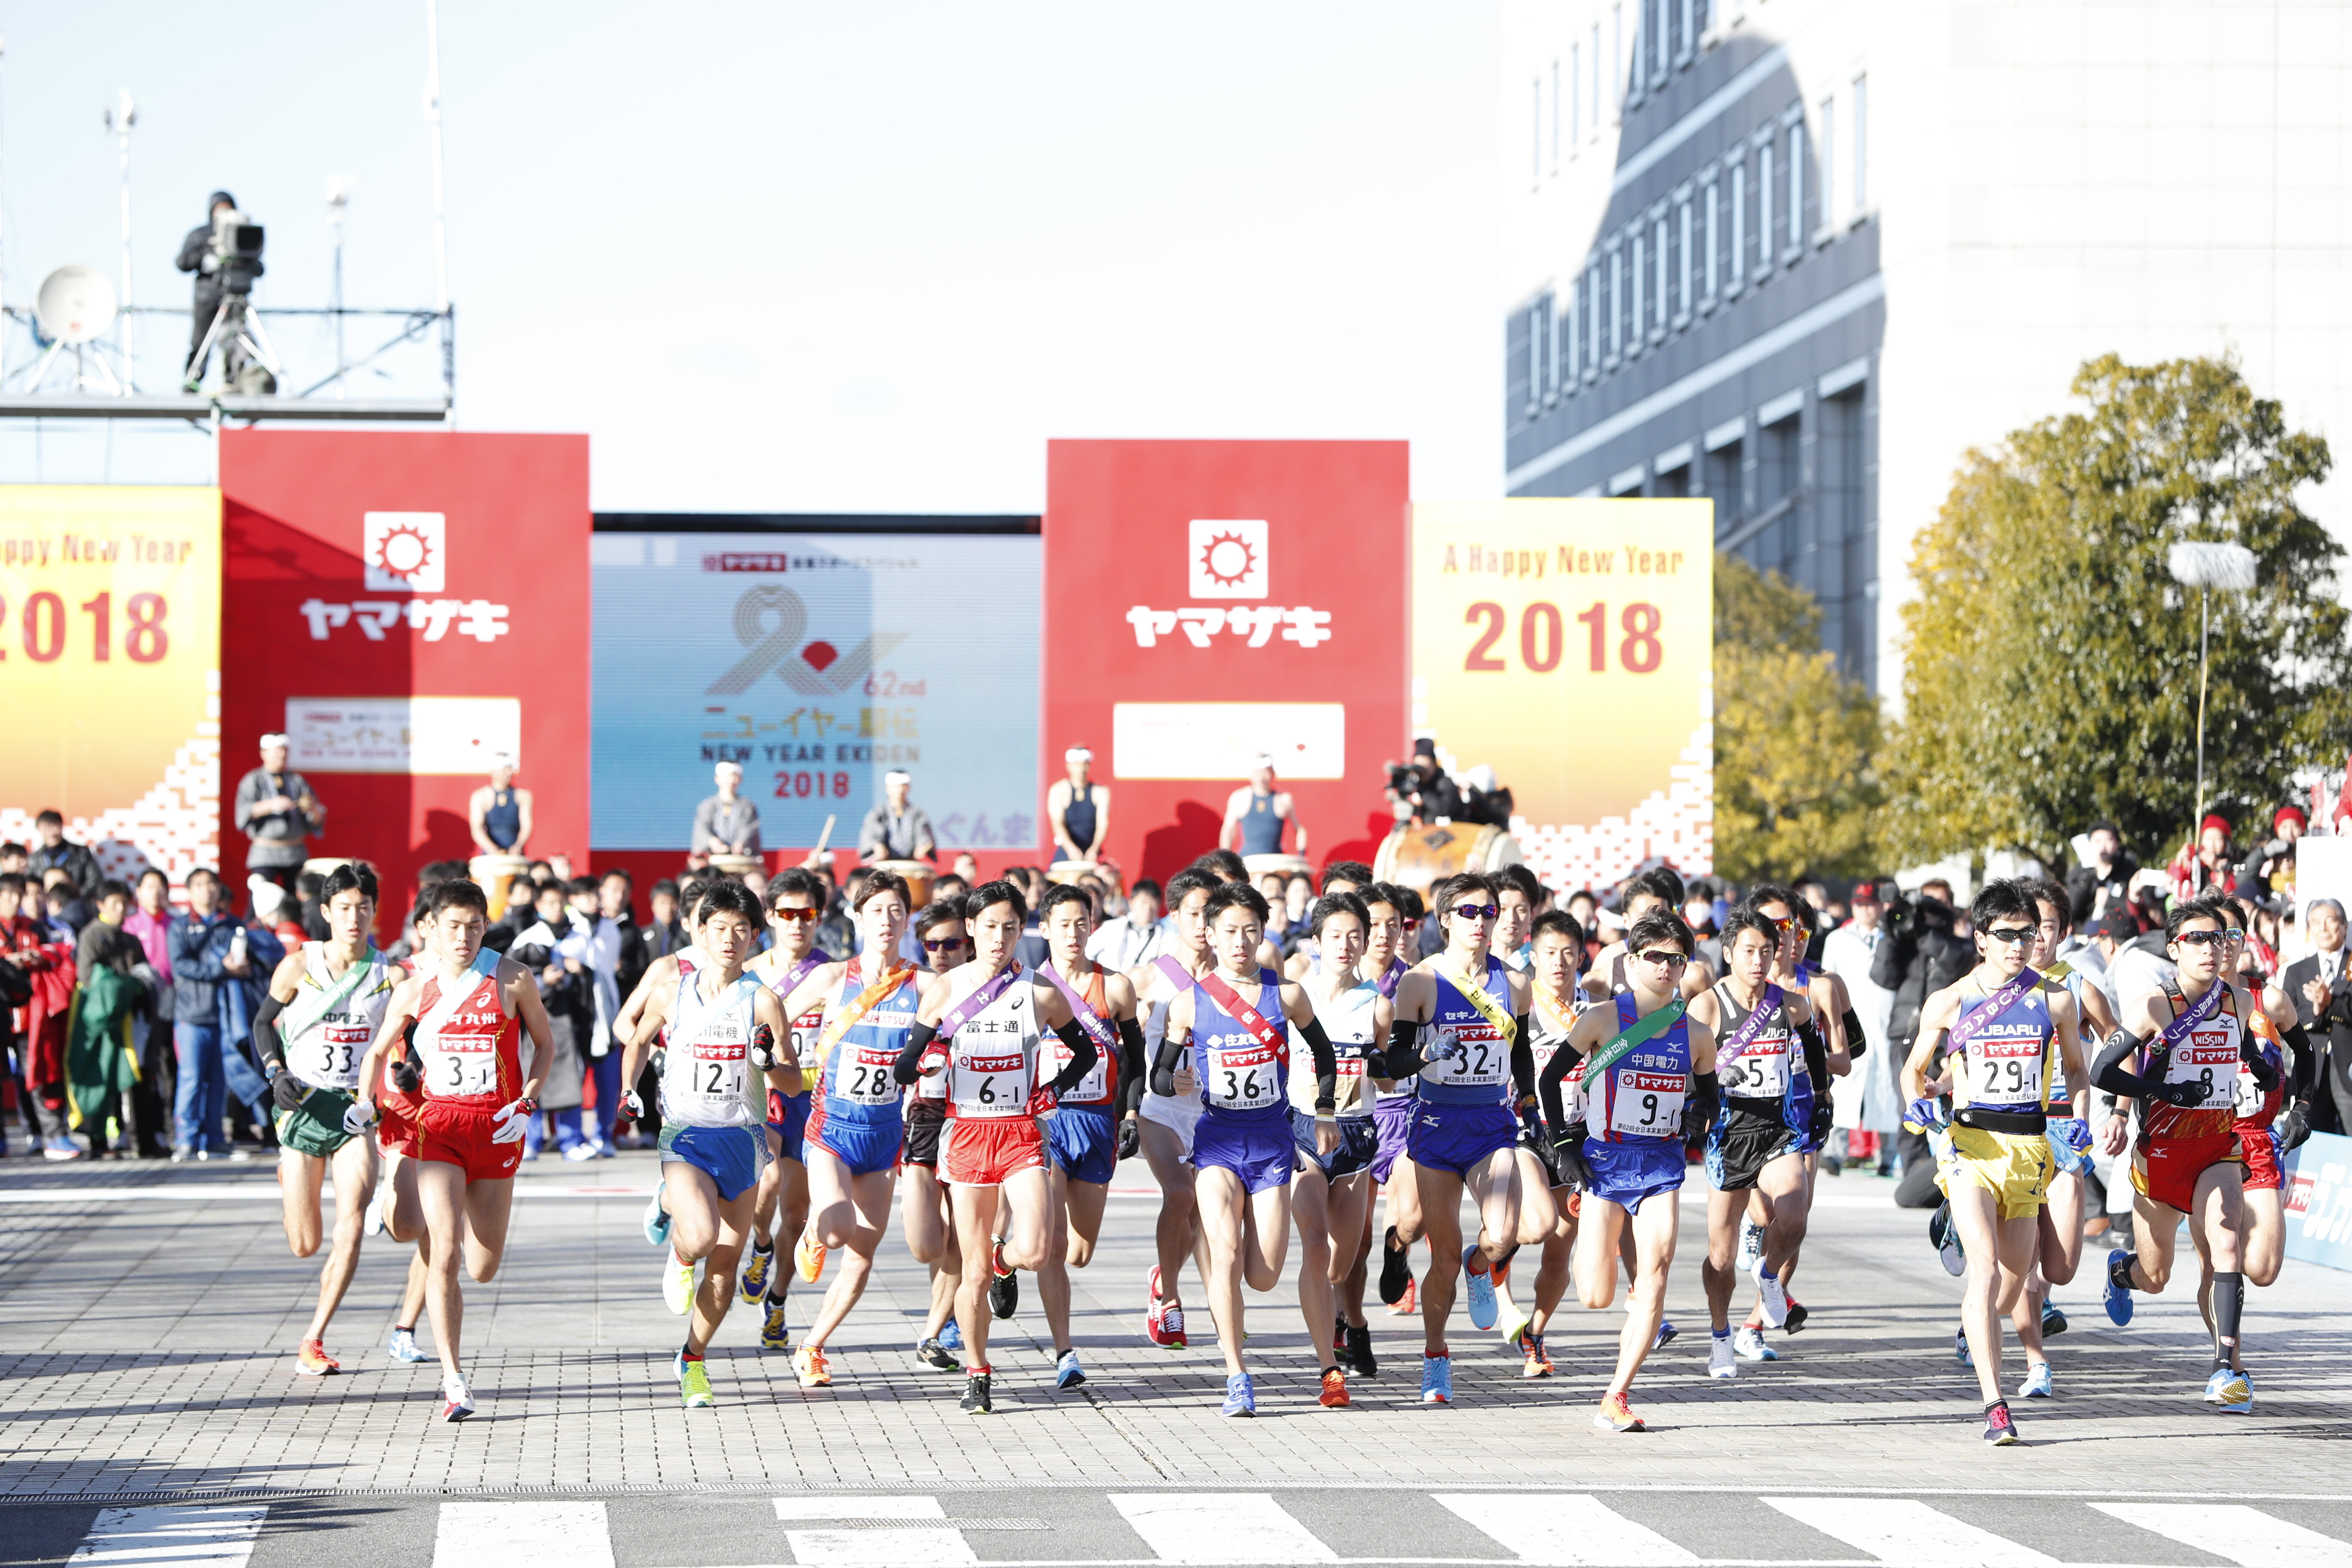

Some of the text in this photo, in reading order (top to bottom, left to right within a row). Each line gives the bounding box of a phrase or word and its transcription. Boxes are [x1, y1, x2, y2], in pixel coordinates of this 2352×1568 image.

[6, 535, 192, 567] ppy New Year
[1444, 545, 1683, 578] A Happy New Year
[0, 592, 168, 662] 018
[300, 599, 510, 642] ヤマザキ
[1126, 605, 1332, 648] ヤマザキ
[1464, 602, 1663, 673] 2018
[863, 672, 926, 697] 62nd
[700, 745, 919, 763] NEW YEAR EKIDEN
[775, 770, 850, 799] 2018
[444, 1013, 496, 1025] タ九州
[966, 1020, 1019, 1033] 富士通
[326, 1029, 368, 1041] ヤマザキ
[700, 1025, 738, 1039] 川電機
[1224, 1032, 1262, 1047] 住友電
[1458, 1027, 1502, 1039] ヤマザキ
[2195, 1033, 2225, 1046] NISSIN
[440, 1039, 490, 1050] ヤマザキ
[694, 1046, 743, 1058] ヤマザキ
[1744, 1041, 1785, 1054] ヤマザキ
[1986, 1043, 2039, 1055] ヤマザキ
[860, 1052, 900, 1064] ヤマザ
[972, 1057, 1021, 1069] ヤマザキ
[1223, 1050, 1272, 1065] ヤマザキ
[1452, 1044, 1502, 1075] 32-1
[1632, 1053, 1678, 1070] 中国電力
[2195, 1051, 2236, 1062] ヤマザキ
[447, 1056, 486, 1086] 3-1
[693, 1062, 741, 1093] 12-1
[1749, 1059, 1783, 1087] 5-1
[1983, 1060, 2036, 1093] 29-1
[979, 1075, 1018, 1104] 6-1
[1223, 1069, 1274, 1100] 36-1
[1638, 1076, 1684, 1090] ヤマザキ
[2200, 1067, 2232, 1099] 8-1
[1639, 1094, 1675, 1126] 9-1
